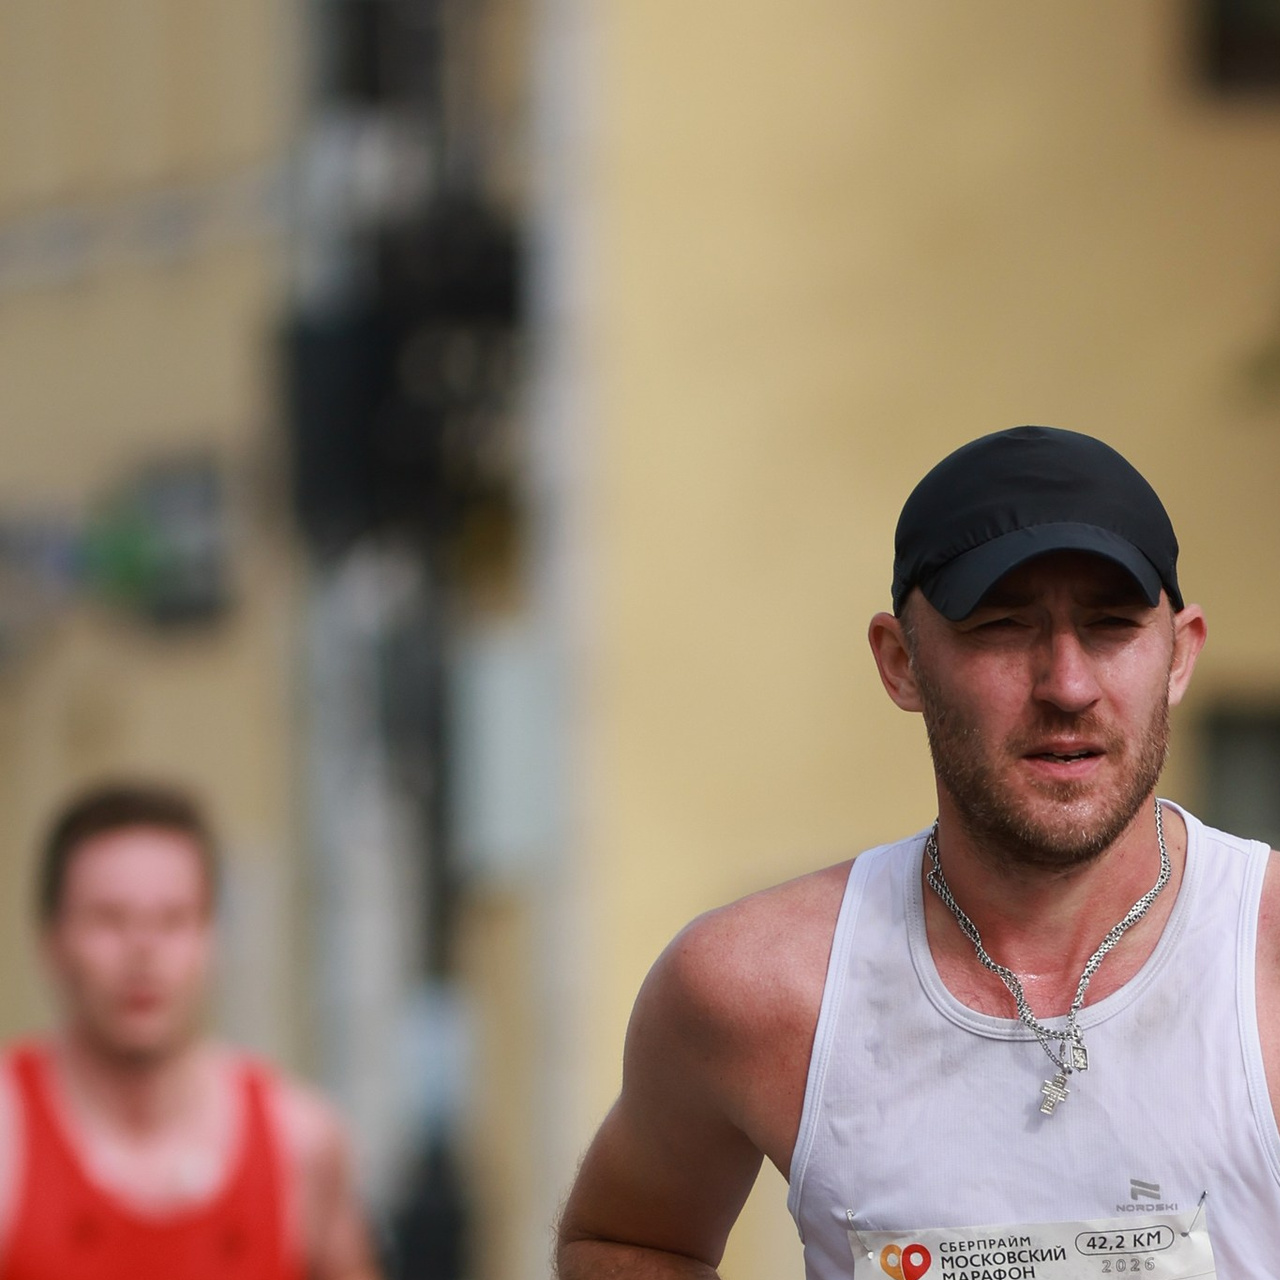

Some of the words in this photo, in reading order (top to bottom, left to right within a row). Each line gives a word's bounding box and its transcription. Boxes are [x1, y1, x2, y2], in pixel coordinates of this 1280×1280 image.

[1116, 1203, 1178, 1212] NORDSKI
[939, 1236, 1032, 1253] СБЕРПРАЙМ
[1086, 1235, 1125, 1250] 42,2
[1133, 1231, 1161, 1247] КМ
[941, 1245, 1067, 1270] МОСКОВСКИЙ
[1102, 1257, 1156, 1273] 2026
